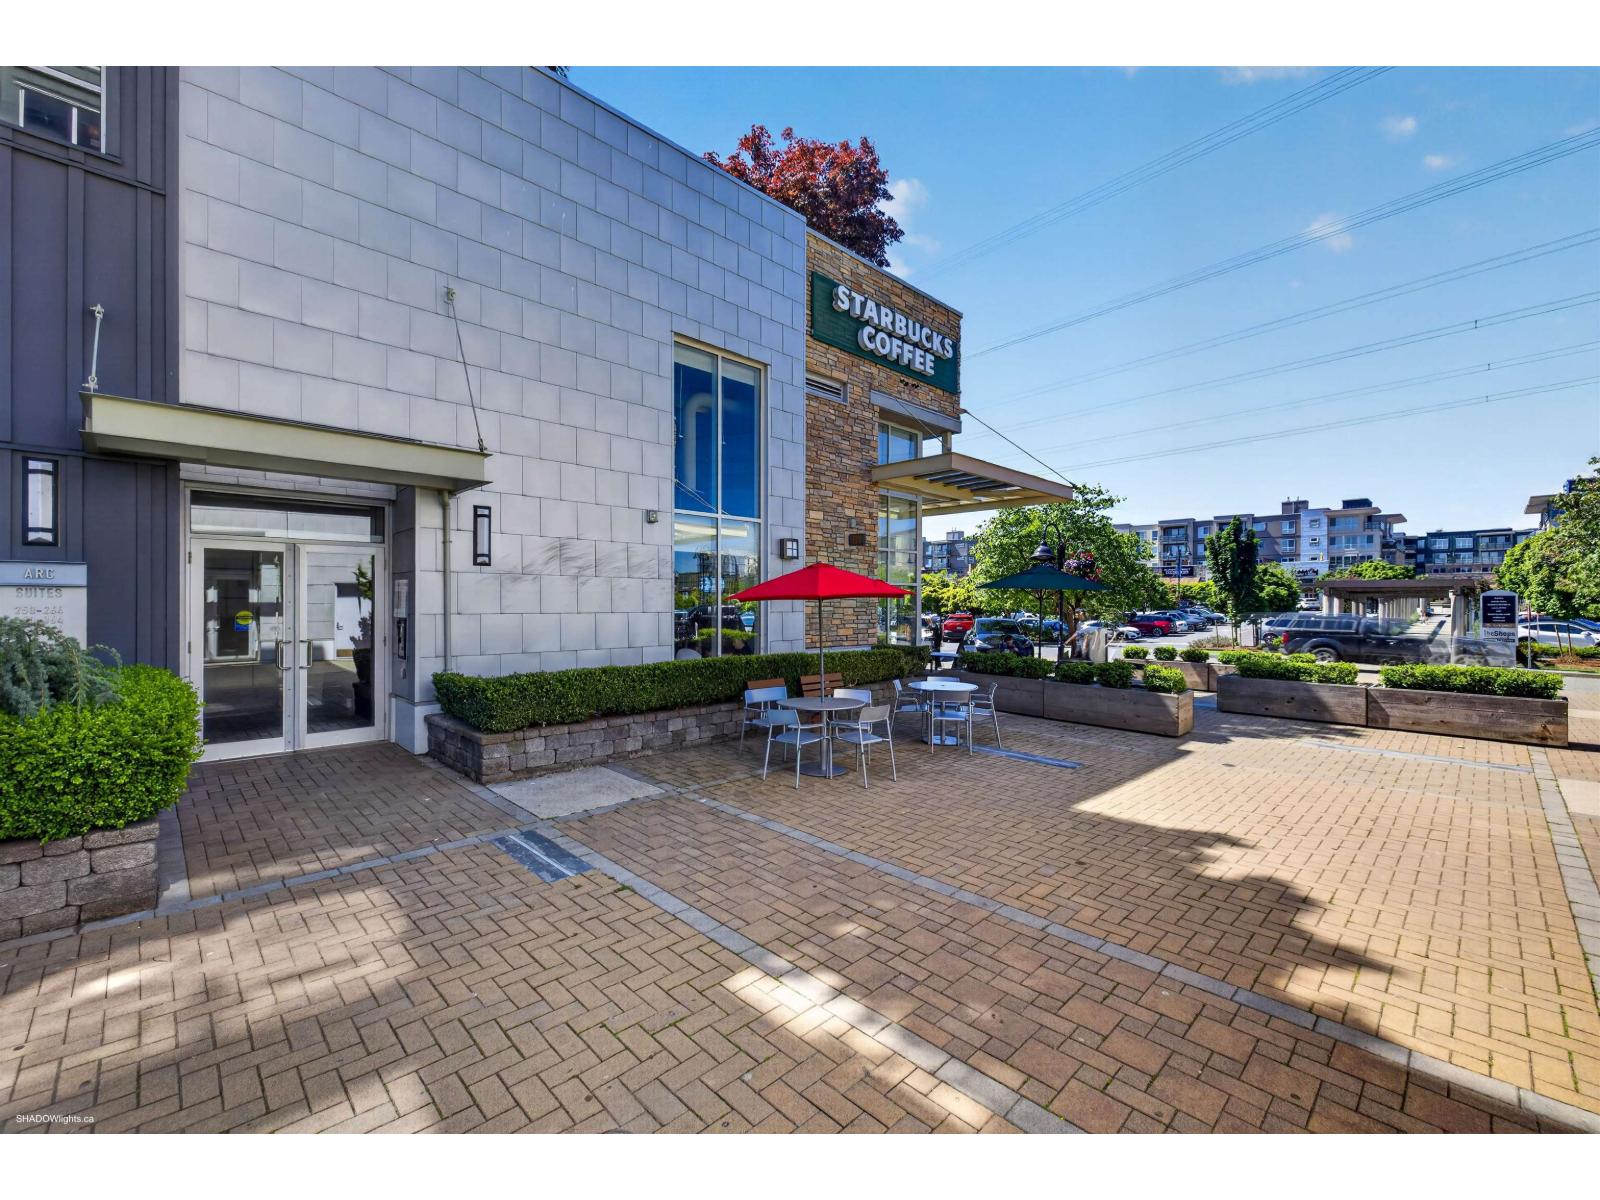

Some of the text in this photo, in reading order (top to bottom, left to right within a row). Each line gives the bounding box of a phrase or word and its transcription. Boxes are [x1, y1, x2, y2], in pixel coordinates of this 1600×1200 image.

[832, 284, 954, 359] STARBUCKS
[858, 325, 935, 377] COFFEE
[24, 567, 56, 579] ARC
[15, 586, 63, 598] SUITES
